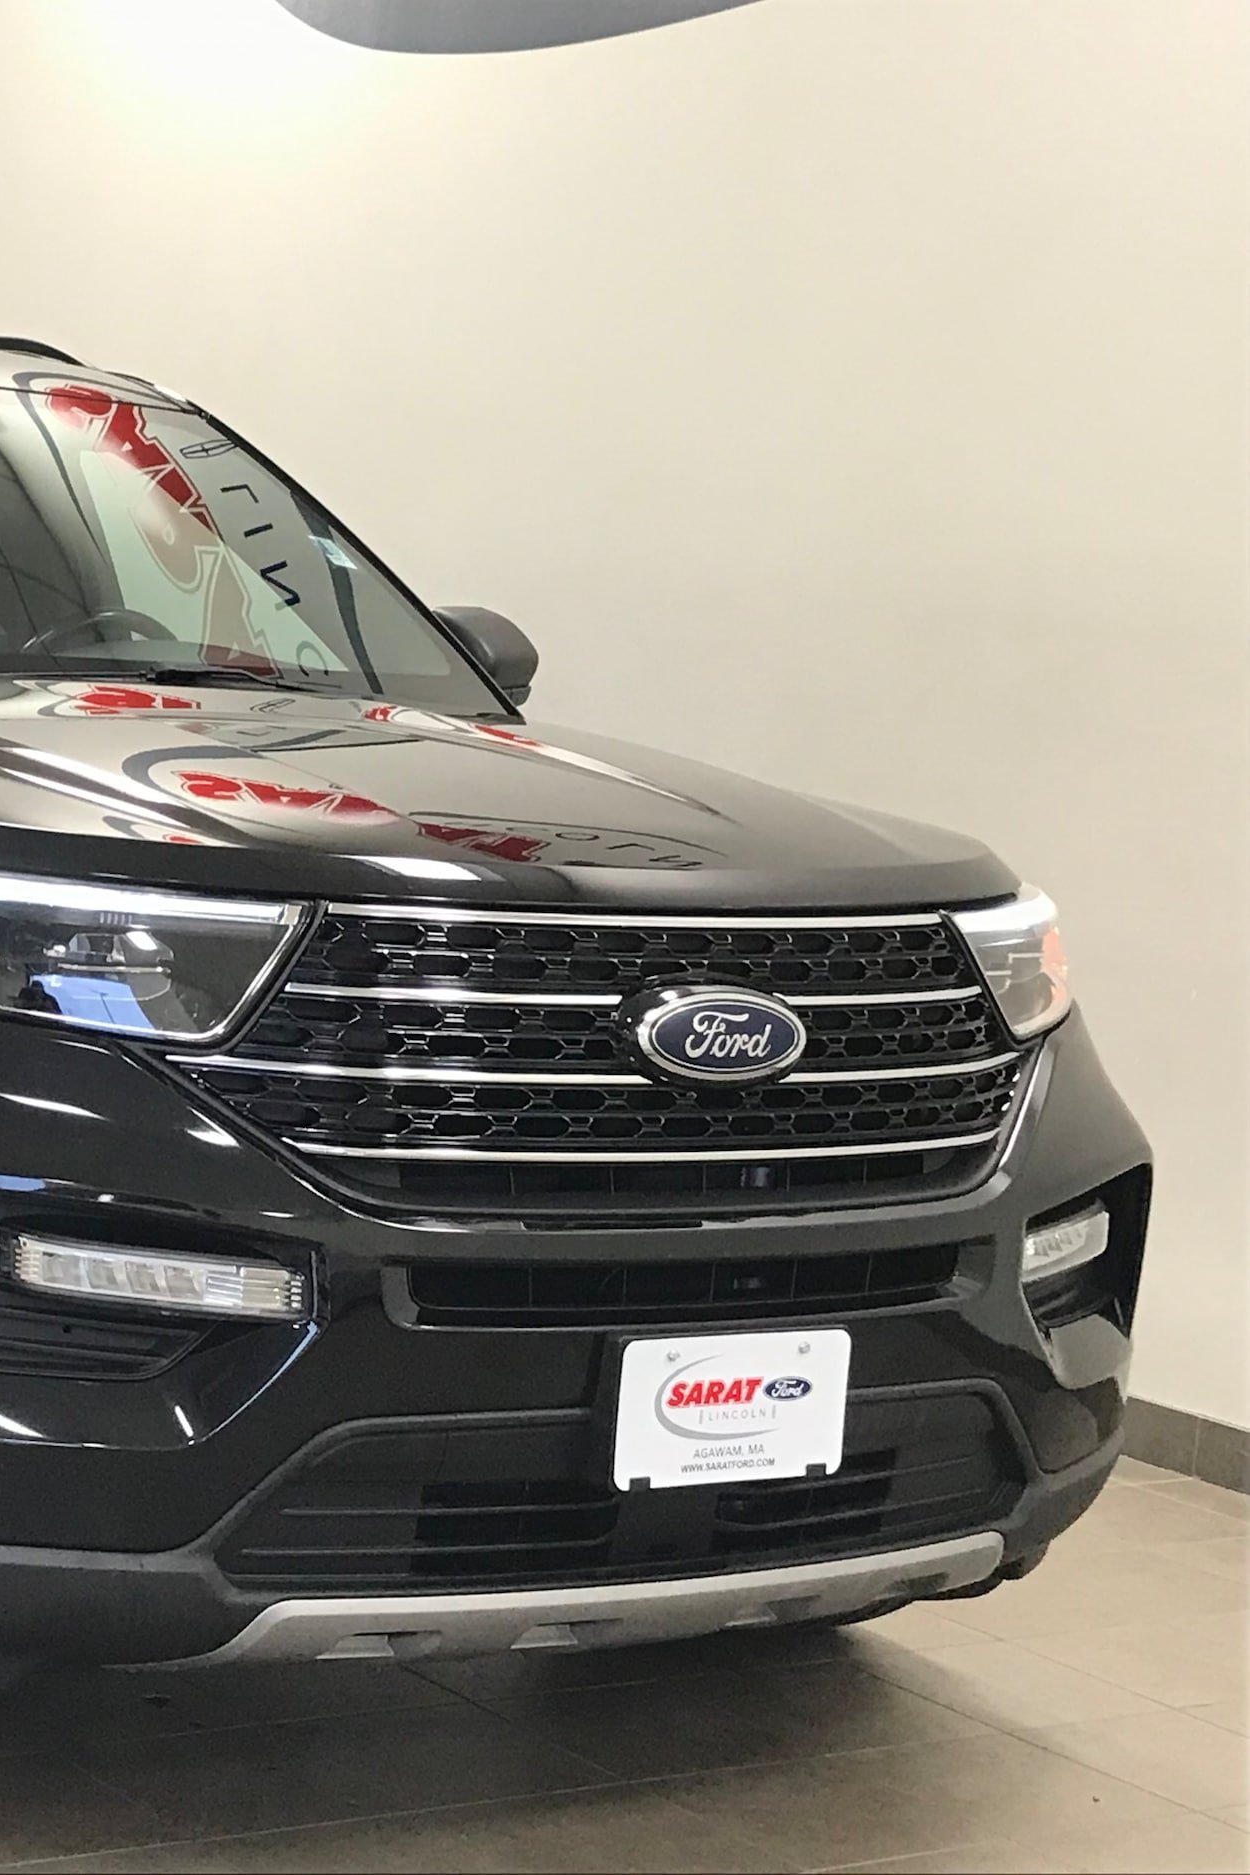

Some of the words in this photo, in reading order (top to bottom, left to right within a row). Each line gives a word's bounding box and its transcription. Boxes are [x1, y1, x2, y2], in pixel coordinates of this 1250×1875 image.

[684, 1011, 773, 1058] Ford
[667, 1378, 763, 1407] SARAT
[770, 1379, 805, 1398] Ford
[708, 1408, 767, 1422] LINCOLN
[693, 1445, 745, 1459] AGAWAM,
[748, 1443, 765, 1455] MA
[680, 1457, 776, 1473] WWW.SARATFORD.COM
